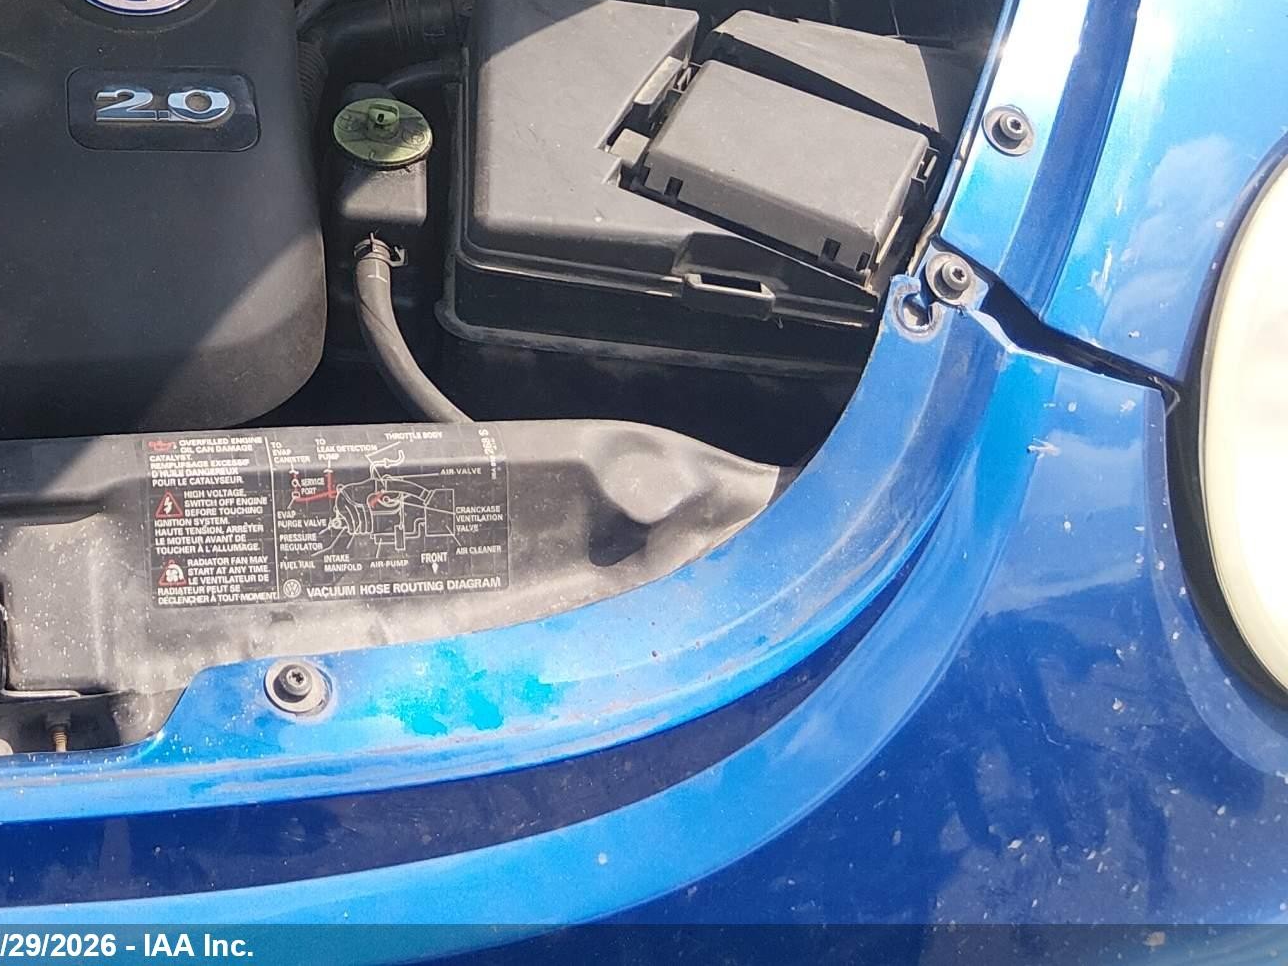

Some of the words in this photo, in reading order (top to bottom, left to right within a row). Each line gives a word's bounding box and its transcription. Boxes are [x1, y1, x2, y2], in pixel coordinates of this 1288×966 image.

[95, 88, 231, 124] 2.0
[384, 432, 422, 441] THROTTLE
[423, 431, 443, 439] BODY
[179, 438, 229, 447] OVERFILLED
[230, 436, 263, 445] ENGINE
[314, 438, 326, 446] TO
[180, 446, 194, 454] OIL
[195, 445, 214, 453] CAN
[216, 444, 253, 452] DAMAGE
[272, 448, 292, 456] EVAP
[316, 445, 335, 453] LEAK
[336, 444, 378, 452] DETECTION
[149, 454, 192, 462] CATALYST.
[273, 455, 311, 464] CANISTER
[318, 453, 340, 461] PUMP
[456, 467, 482, 475] VALVE
[152, 478, 176, 487] POUR
[177, 478, 187, 486] LE
[189, 476, 244, 485] CATALYSEUR.
[300, 477, 325, 486] SERVICE
[184, 490, 205, 499] HIGH
[300, 487, 317, 495] PORT
[184, 498, 217, 508] SWITCH
[219, 498, 235, 506] OFF
[236, 496, 268, 506] ENGINE
[184, 507, 217, 516] BEFORE
[219, 506, 263, 515] TOUCHING
[455, 505, 500, 514] CRANCKASE
[277, 511, 296, 519] EVAP
[456, 514, 503, 523] VENTILATION
[154, 519, 192, 527] IGNITION
[193, 517, 230, 526] SYSTEM.
[277, 519, 303, 528] PURGE
[304, 518, 327, 527] VALVE
[154, 527, 184, 536] HAUTE
[456, 524, 479, 532] VALVE
[155, 537, 166, 545] LE
[167, 536, 204, 545] MOTEUR
[205, 535, 233, 543] AVANT
[234, 534, 247, 543] DE
[279, 533, 317, 542] PRESSURE
[155, 546, 196, 555] TOUCHER
[279, 542, 323, 551] REGULATOR
[455, 547, 468, 555] AIR
[469, 545, 501, 554] CLEANER
[187, 557, 229, 567] RADIATOR
[231, 556, 248, 565] FAN
[249, 555, 268, 564] MAY
[323, 554, 350, 563] INTAKE
[420, 551, 448, 563] FRONT
[279, 561, 298, 570] FUEL
[324, 563, 363, 572] MANIFOLD
[370, 560, 384, 568] AIR
[385, 559, 409, 567] PUMP
[187, 567, 215, 576] START
[216, 566, 227, 575] AT
[228, 566, 247, 574] ANY
[248, 565, 271, 574] TIME.
[188, 577, 198, 585] LE
[200, 575, 256, 585] VENTILATEUR
[257, 574, 269, 582] DE
[157, 586, 205, 596] RADIATEUR
[206, 585, 228, 594] PEUT
[229, 584, 241, 593] SE
[307, 585, 356, 598] VACUUM
[360, 583, 390, 595] HOSE
[393, 580, 444, 593] ROUTING
[447, 576, 501, 590] DIAGRAM
[217, 594, 239, 602] TOUT
